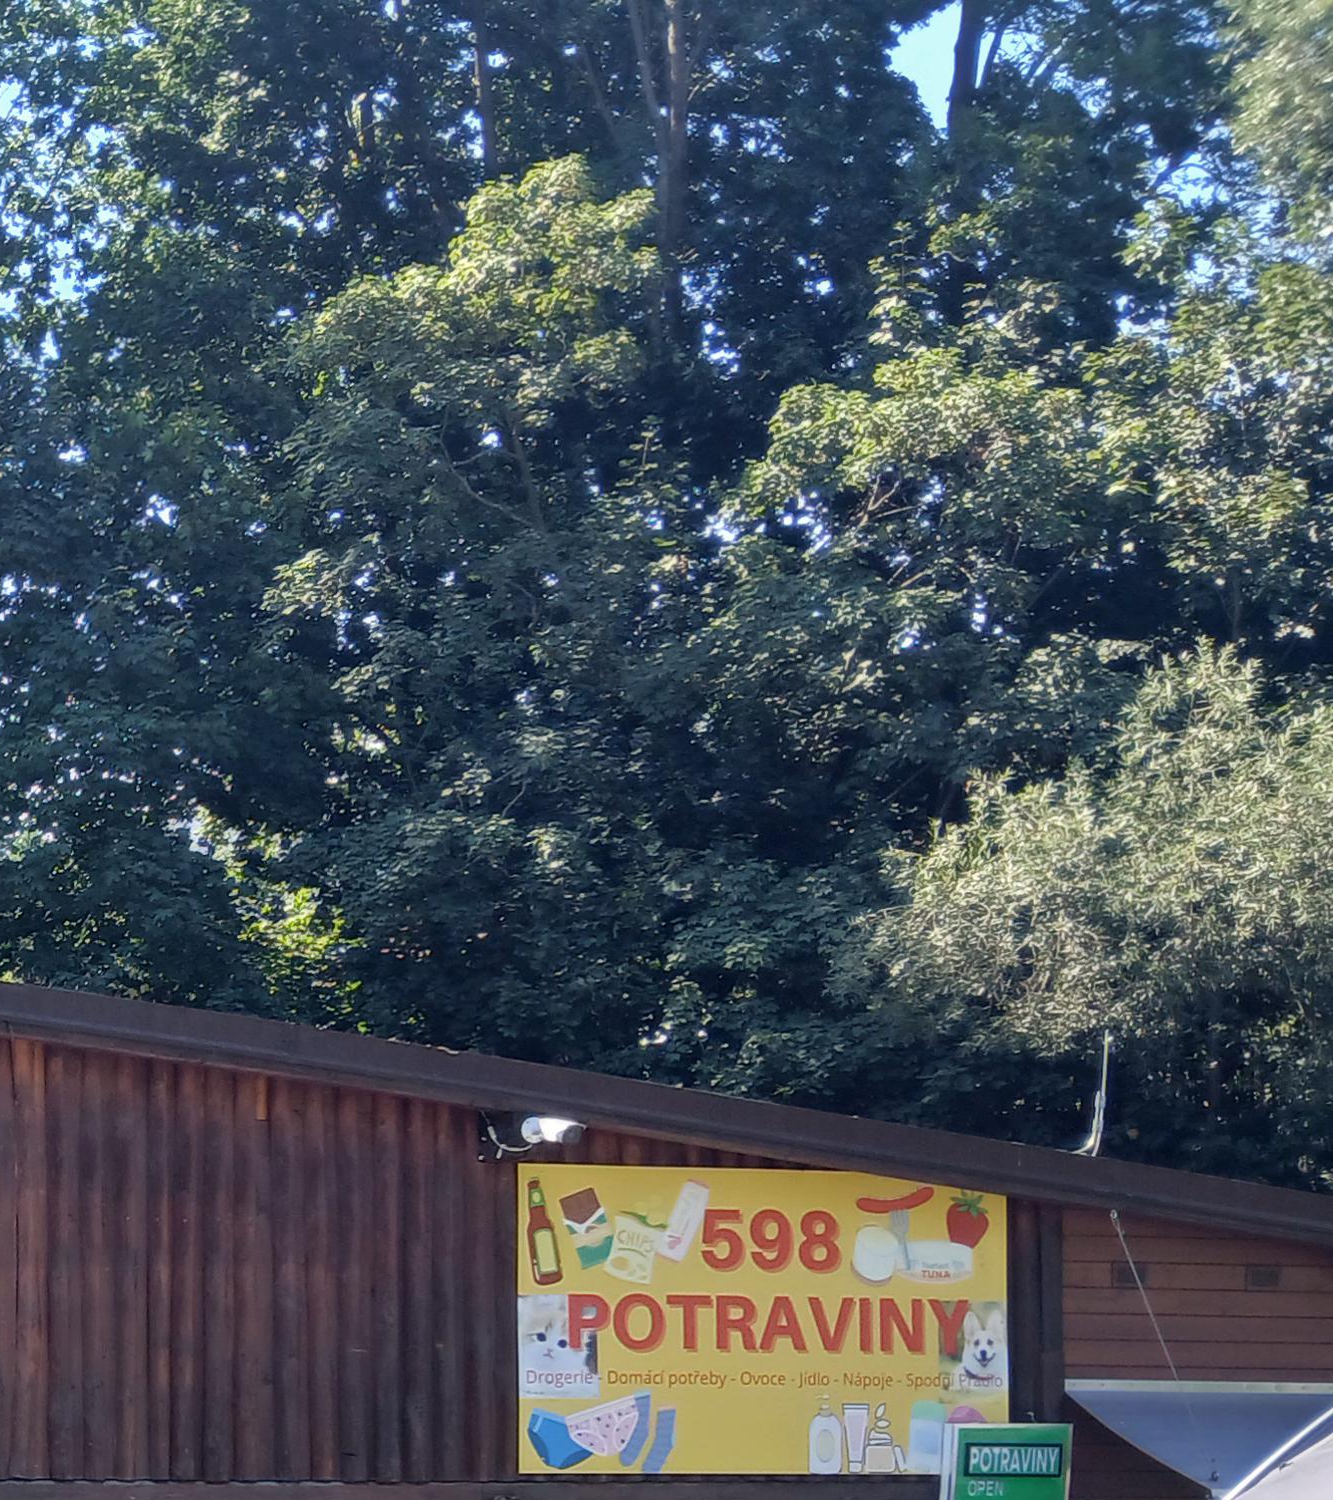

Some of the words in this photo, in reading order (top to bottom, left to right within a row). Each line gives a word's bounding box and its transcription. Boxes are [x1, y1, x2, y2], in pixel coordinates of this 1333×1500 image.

[617, 1230, 655, 1252] CHIPS
[701, 1209, 841, 1273] 598
[921, 1269, 950, 1279] TUNA
[567, 1293, 971, 1357] POTRAVINY
[526, 1370, 593, 1387] Drogerie
[607, 1370, 664, 1385] Domácí
[668, 1371, 727, 1388] potřeby
[740, 1371, 786, 1386] Ovoce
[797, 1372, 830, 1388] Jídlo
[843, 1372, 894, 1389] Nápoje
[968, 1446, 1060, 1474] POTRAVINY
[967, 1480, 1004, 1496] OPEN
